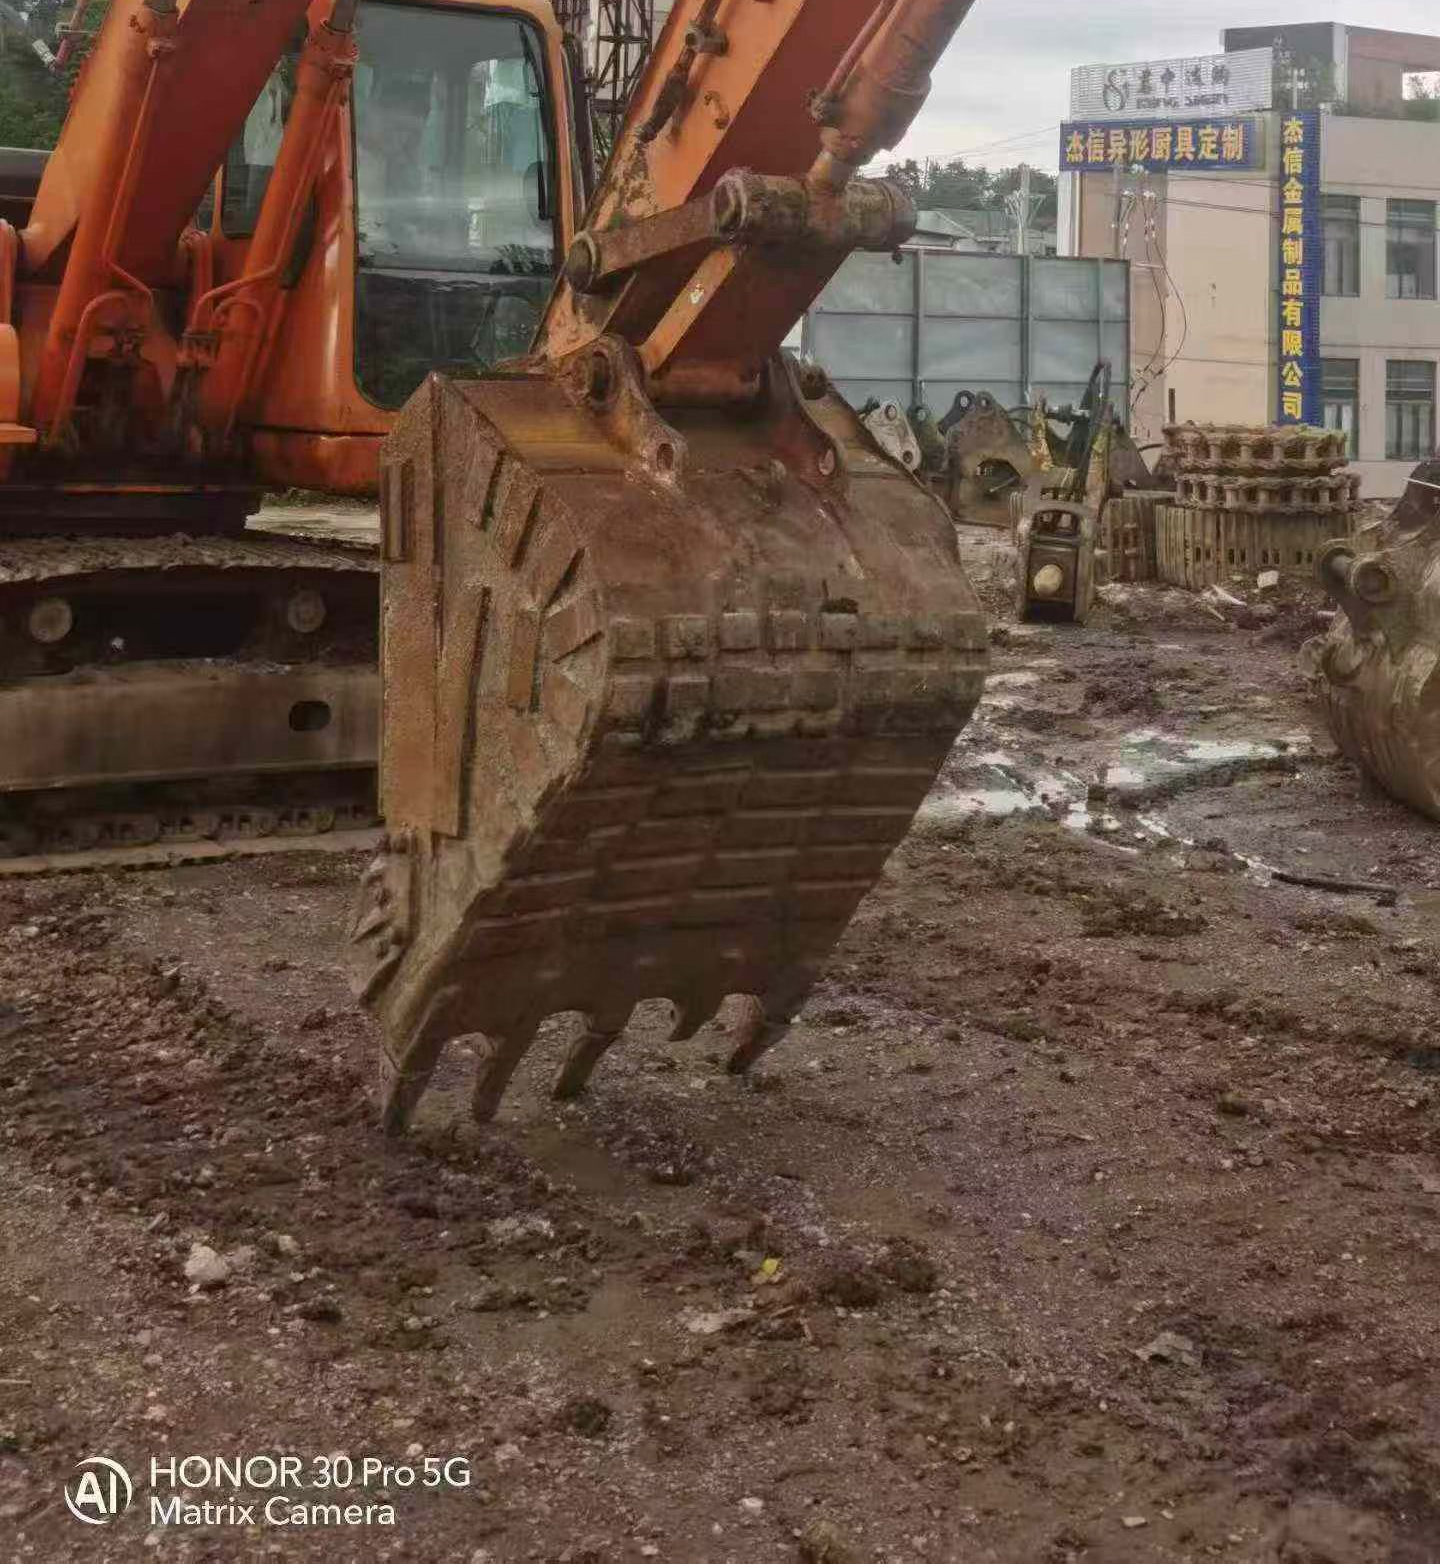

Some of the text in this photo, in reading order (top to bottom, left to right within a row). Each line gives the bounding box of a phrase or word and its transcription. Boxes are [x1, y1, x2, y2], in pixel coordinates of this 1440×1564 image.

[1066, 124, 1244, 165] 杰信异形厨具定制
[1281, 118, 1304, 420] 杰信金属制品有限公司
